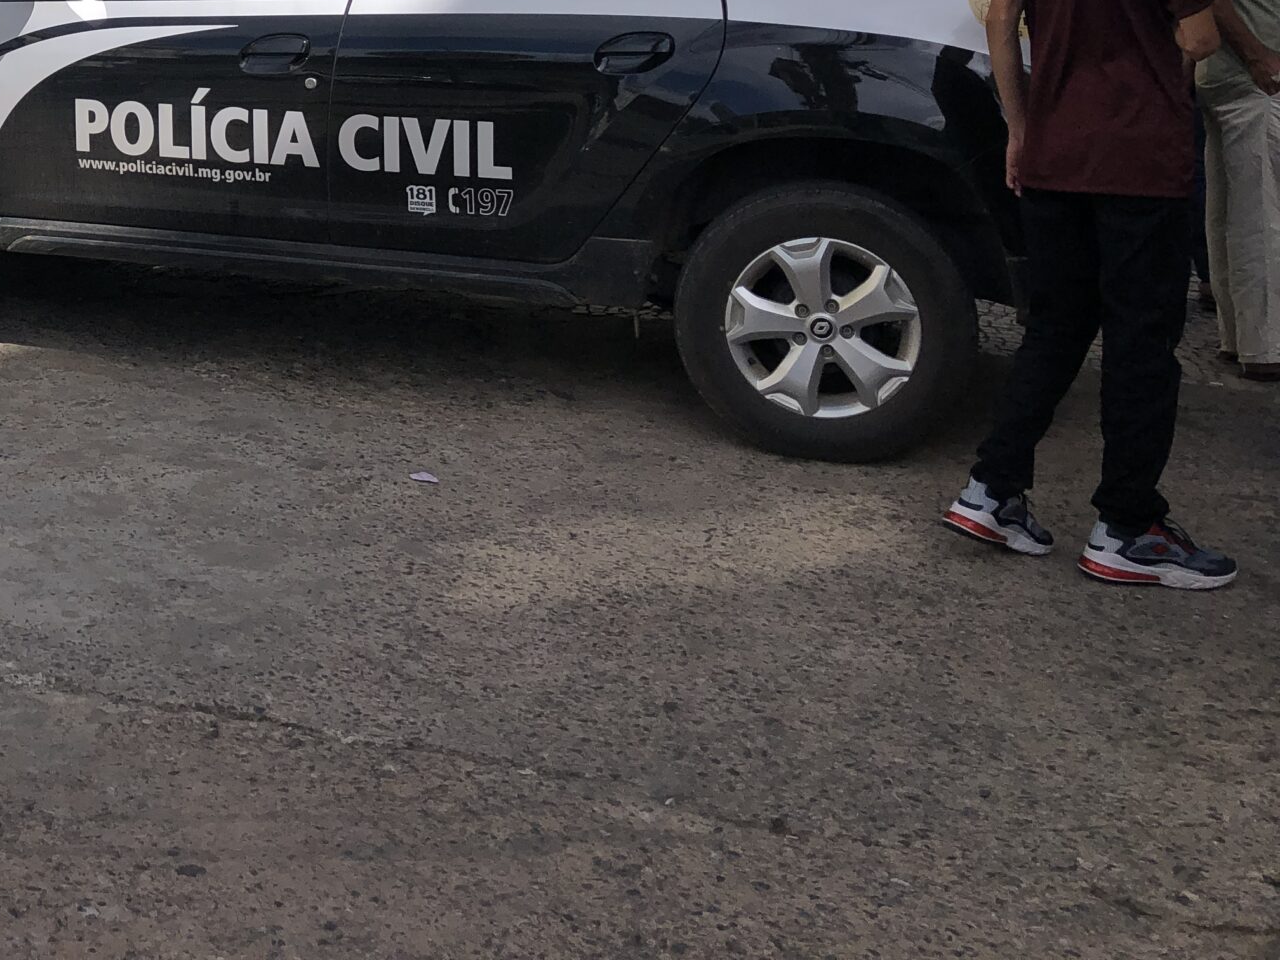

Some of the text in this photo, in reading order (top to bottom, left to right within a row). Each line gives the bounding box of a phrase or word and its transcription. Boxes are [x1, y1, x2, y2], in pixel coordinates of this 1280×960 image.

[74, 87, 513, 180] POLÍCIA CIVIL
[78, 157, 271, 184] www.policiacivil.mg.gov.br
[406, 185, 435, 201] 181
[460, 187, 514, 217] 197
